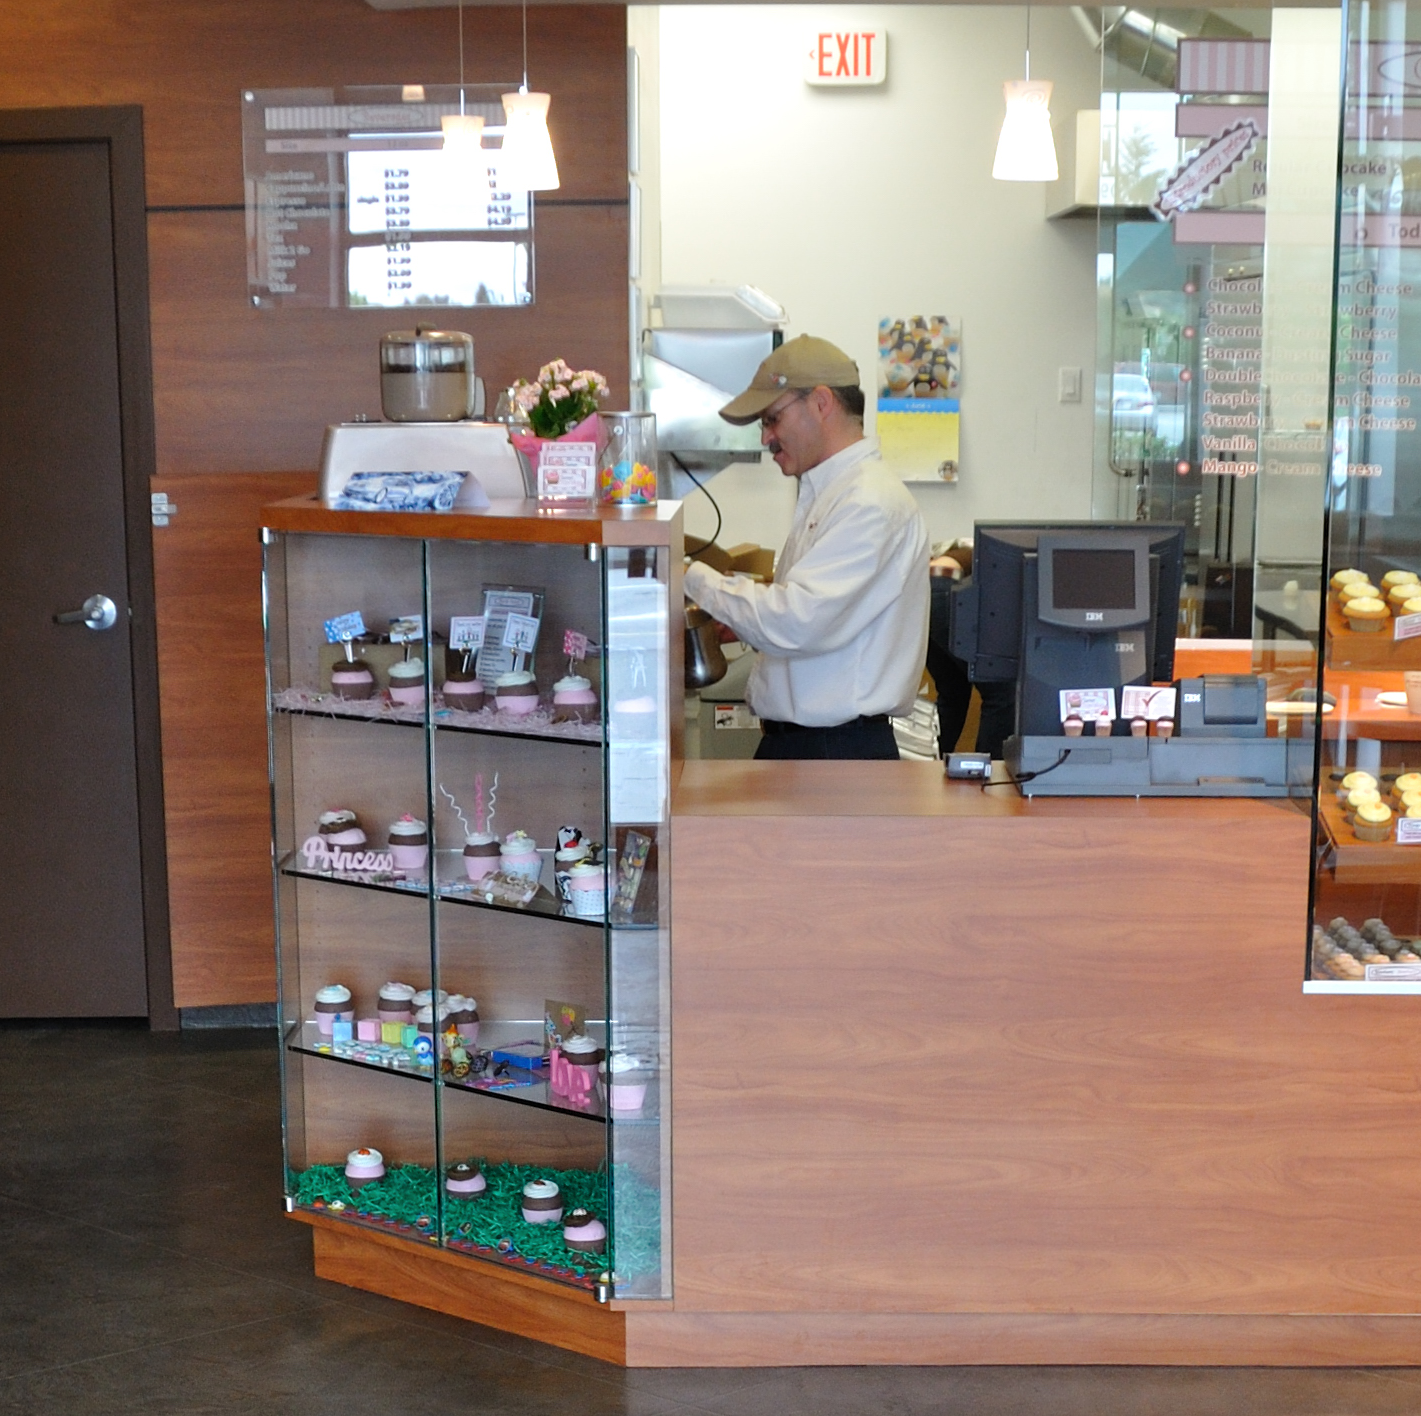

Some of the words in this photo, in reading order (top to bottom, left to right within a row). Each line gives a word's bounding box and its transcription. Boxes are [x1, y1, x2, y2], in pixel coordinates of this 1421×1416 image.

[818, 32, 876, 77] EXIT
[1208, 277, 1270, 293] Chocol
[1355, 280, 1413, 295] Cheese
[1206, 300, 1270, 316] Strawb
[1206, 323, 1266, 338] Coconu
[1339, 325, 1398, 340] Cheese
[1205, 346, 1262, 360] Banana
[1345, 348, 1391, 365] Sugar
[1204, 367, 1262, 383] Double
[1352, 391, 1411, 408] Cheese
[1202, 412, 1269, 428] Strawb
[1358, 413, 1417, 430] Cheese
[1201, 435, 1257, 451] Vanilla
[1264, 435, 1328, 451] Chocol
[1201, 457, 1259, 477] Mango
[1265, 459, 1321, 475] Cream
[1085, 611, 1104, 622] IBM
[1115, 642, 1135, 653] IBM
[1183, 693, 1202, 703] IBM
[303, 835, 394, 872] Princess
